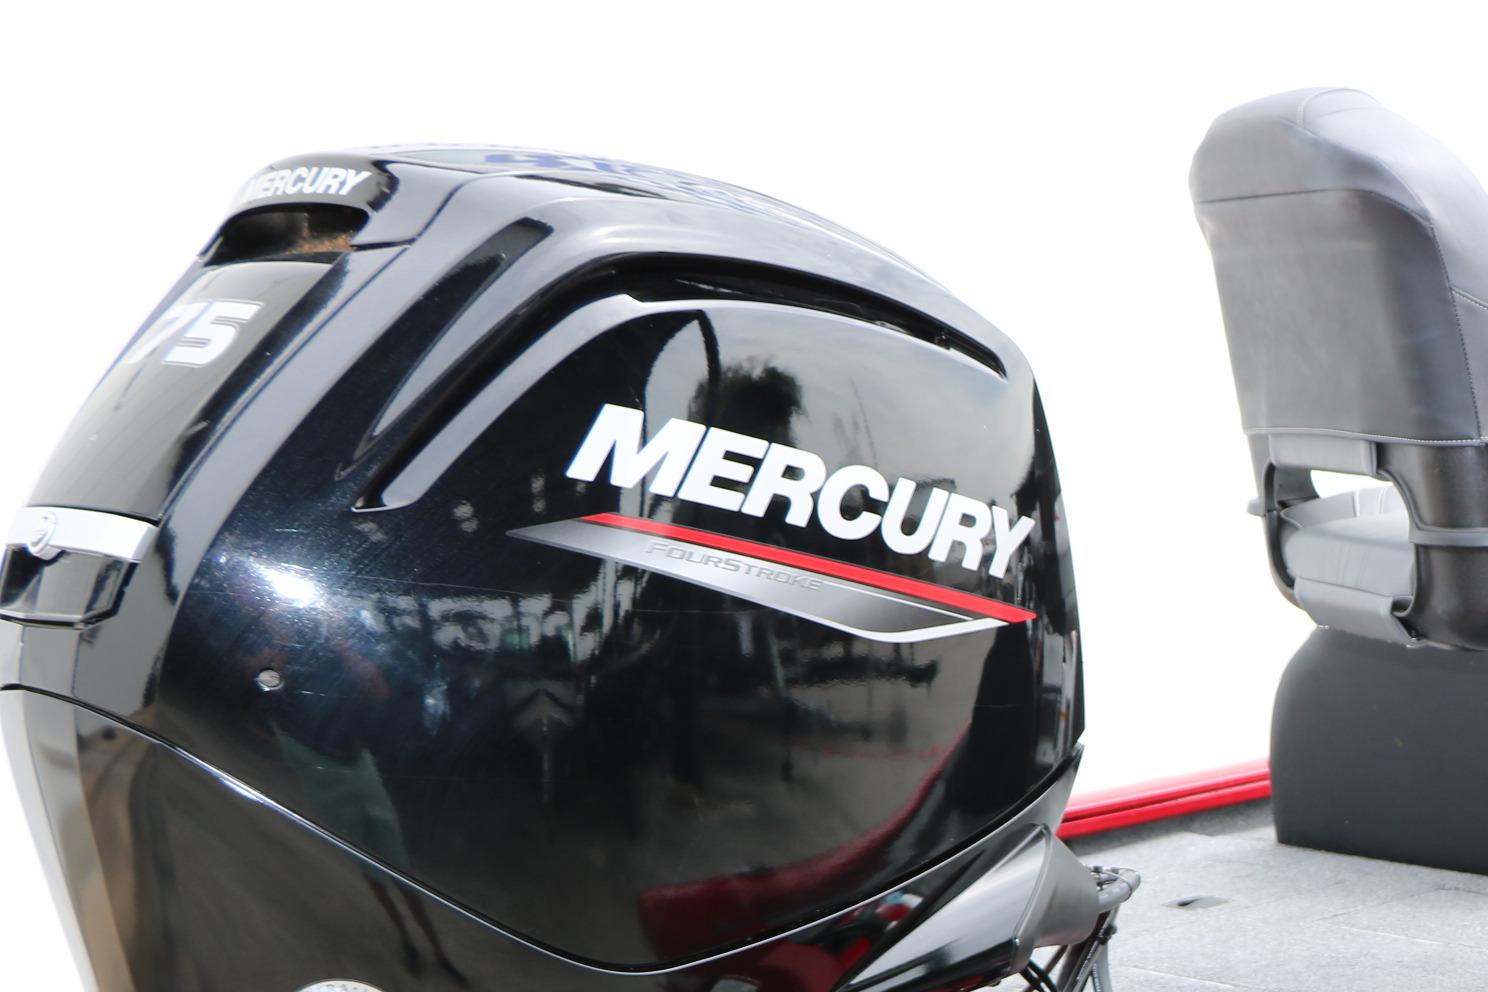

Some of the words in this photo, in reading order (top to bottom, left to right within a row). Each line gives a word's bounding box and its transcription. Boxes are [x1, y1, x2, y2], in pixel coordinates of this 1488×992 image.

[244, 166, 372, 199] MERCURY
[126, 299, 264, 368] 75
[565, 403, 1035, 579] MERCURY
[647, 539, 824, 590] FOURSTROKE
